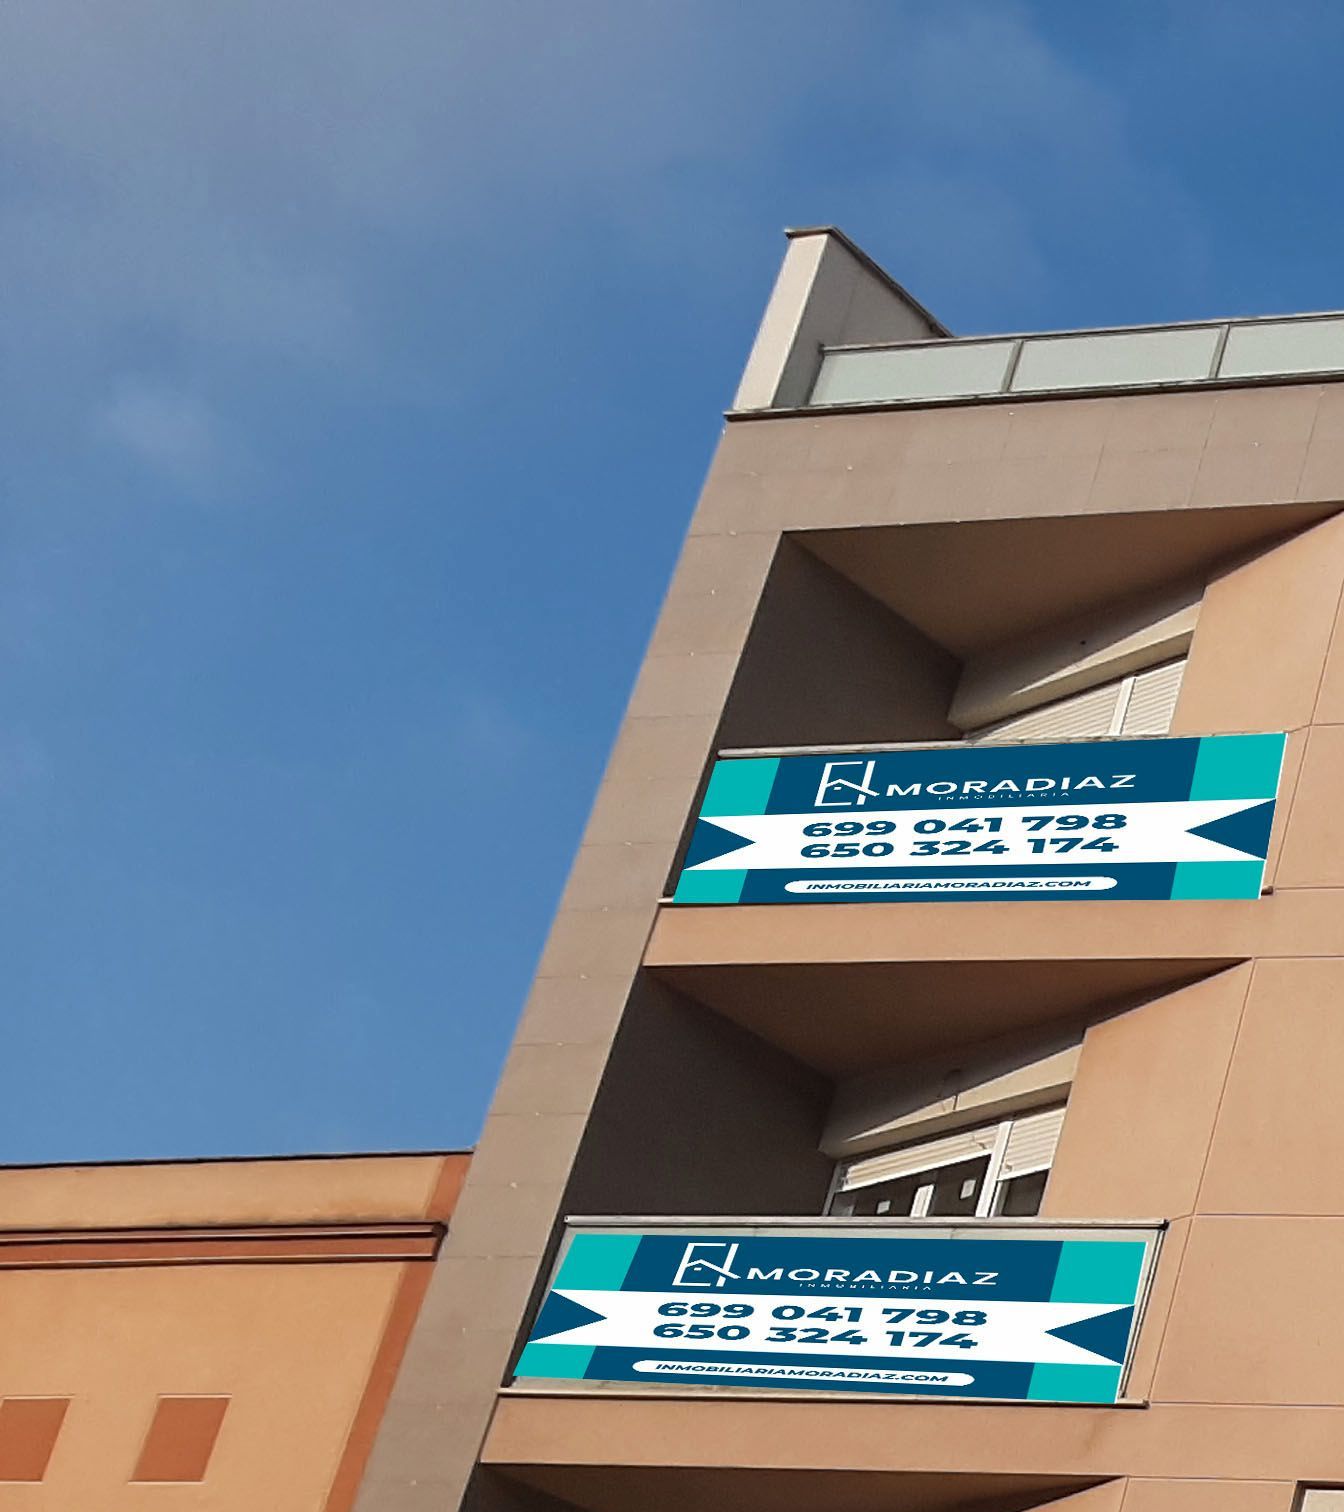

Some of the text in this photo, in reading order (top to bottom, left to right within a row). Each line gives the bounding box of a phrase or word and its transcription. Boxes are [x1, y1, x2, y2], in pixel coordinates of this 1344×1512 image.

[886, 774, 1137, 797] MORADIAZ
[803, 814, 1127, 837] 699 041 798
[801, 837, 1120, 858] 650 324 174
[807, 880, 1092, 890] INMOBILIARIAMORADIAZ.COM
[746, 1268, 999, 1284] MORADIAZ
[658, 1303, 987, 1326] 699 041 798
[654, 1323, 977, 1348] 650 324 174
[655, 1364, 949, 1381] INMOBILIARIAMORADIAZ.COM
